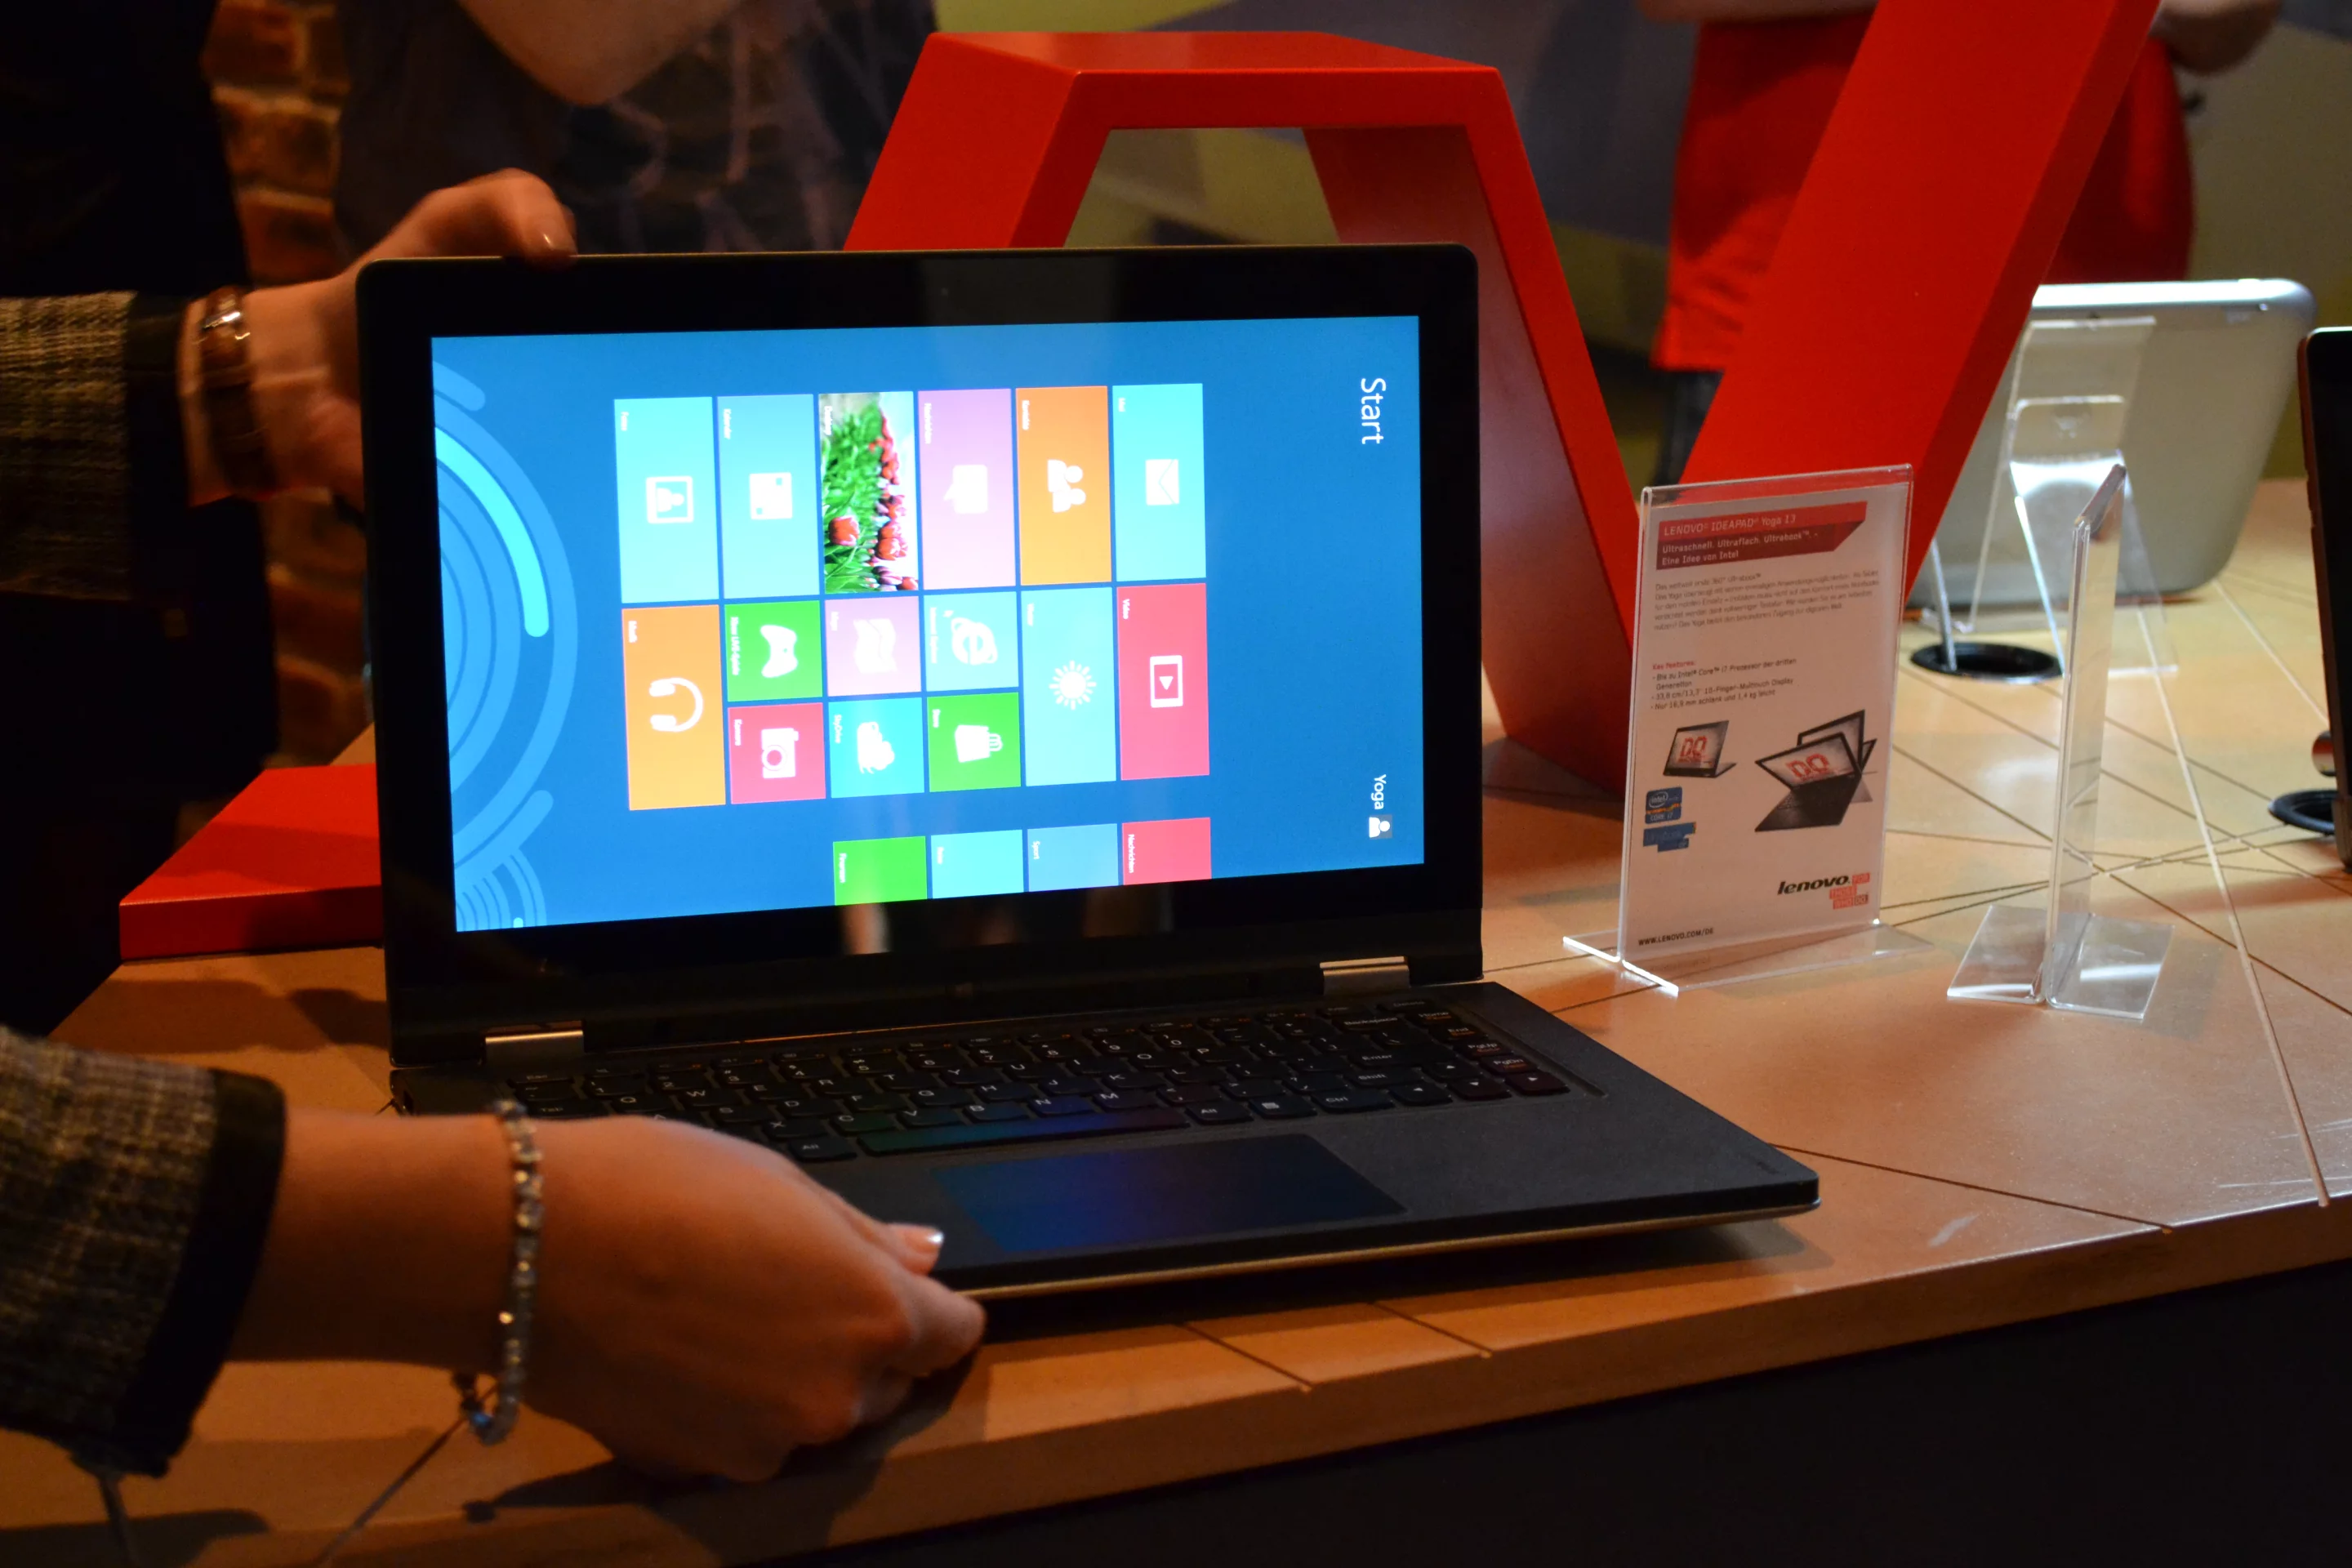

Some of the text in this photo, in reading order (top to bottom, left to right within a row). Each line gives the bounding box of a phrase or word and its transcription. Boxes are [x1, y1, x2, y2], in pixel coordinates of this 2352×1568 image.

[1360, 377, 1388, 445] Start
[724, 408, 732, 439] Kalender
[1762, 517, 1782, 528] Yoga
[1784, 514, 1797, 524] 13
[1662, 541, 1714, 554] Ultraschnell.
[1662, 550, 1739, 566] Eine Idee von Intel
[1122, 599, 1130, 619] Video
[833, 714, 843, 743] SkyDrive
[1371, 774, 1388, 810] Yoga
[1651, 795, 1666, 804] intel
[1031, 841, 1040, 859] Sport
[1127, 834, 1135, 874] Nachrichten
[1777, 875, 1849, 896] lenovo
[1637, 927, 1714, 946] WWW.LENOVO.COM/DE
[1343, 1017, 1398, 1026] Backspace
[1418, 1010, 1450, 1019] Home
[1468, 1042, 1498, 1050] PgUp
[1493, 1058, 1524, 1066] PgDn
[686, 1089, 706, 1098] W
